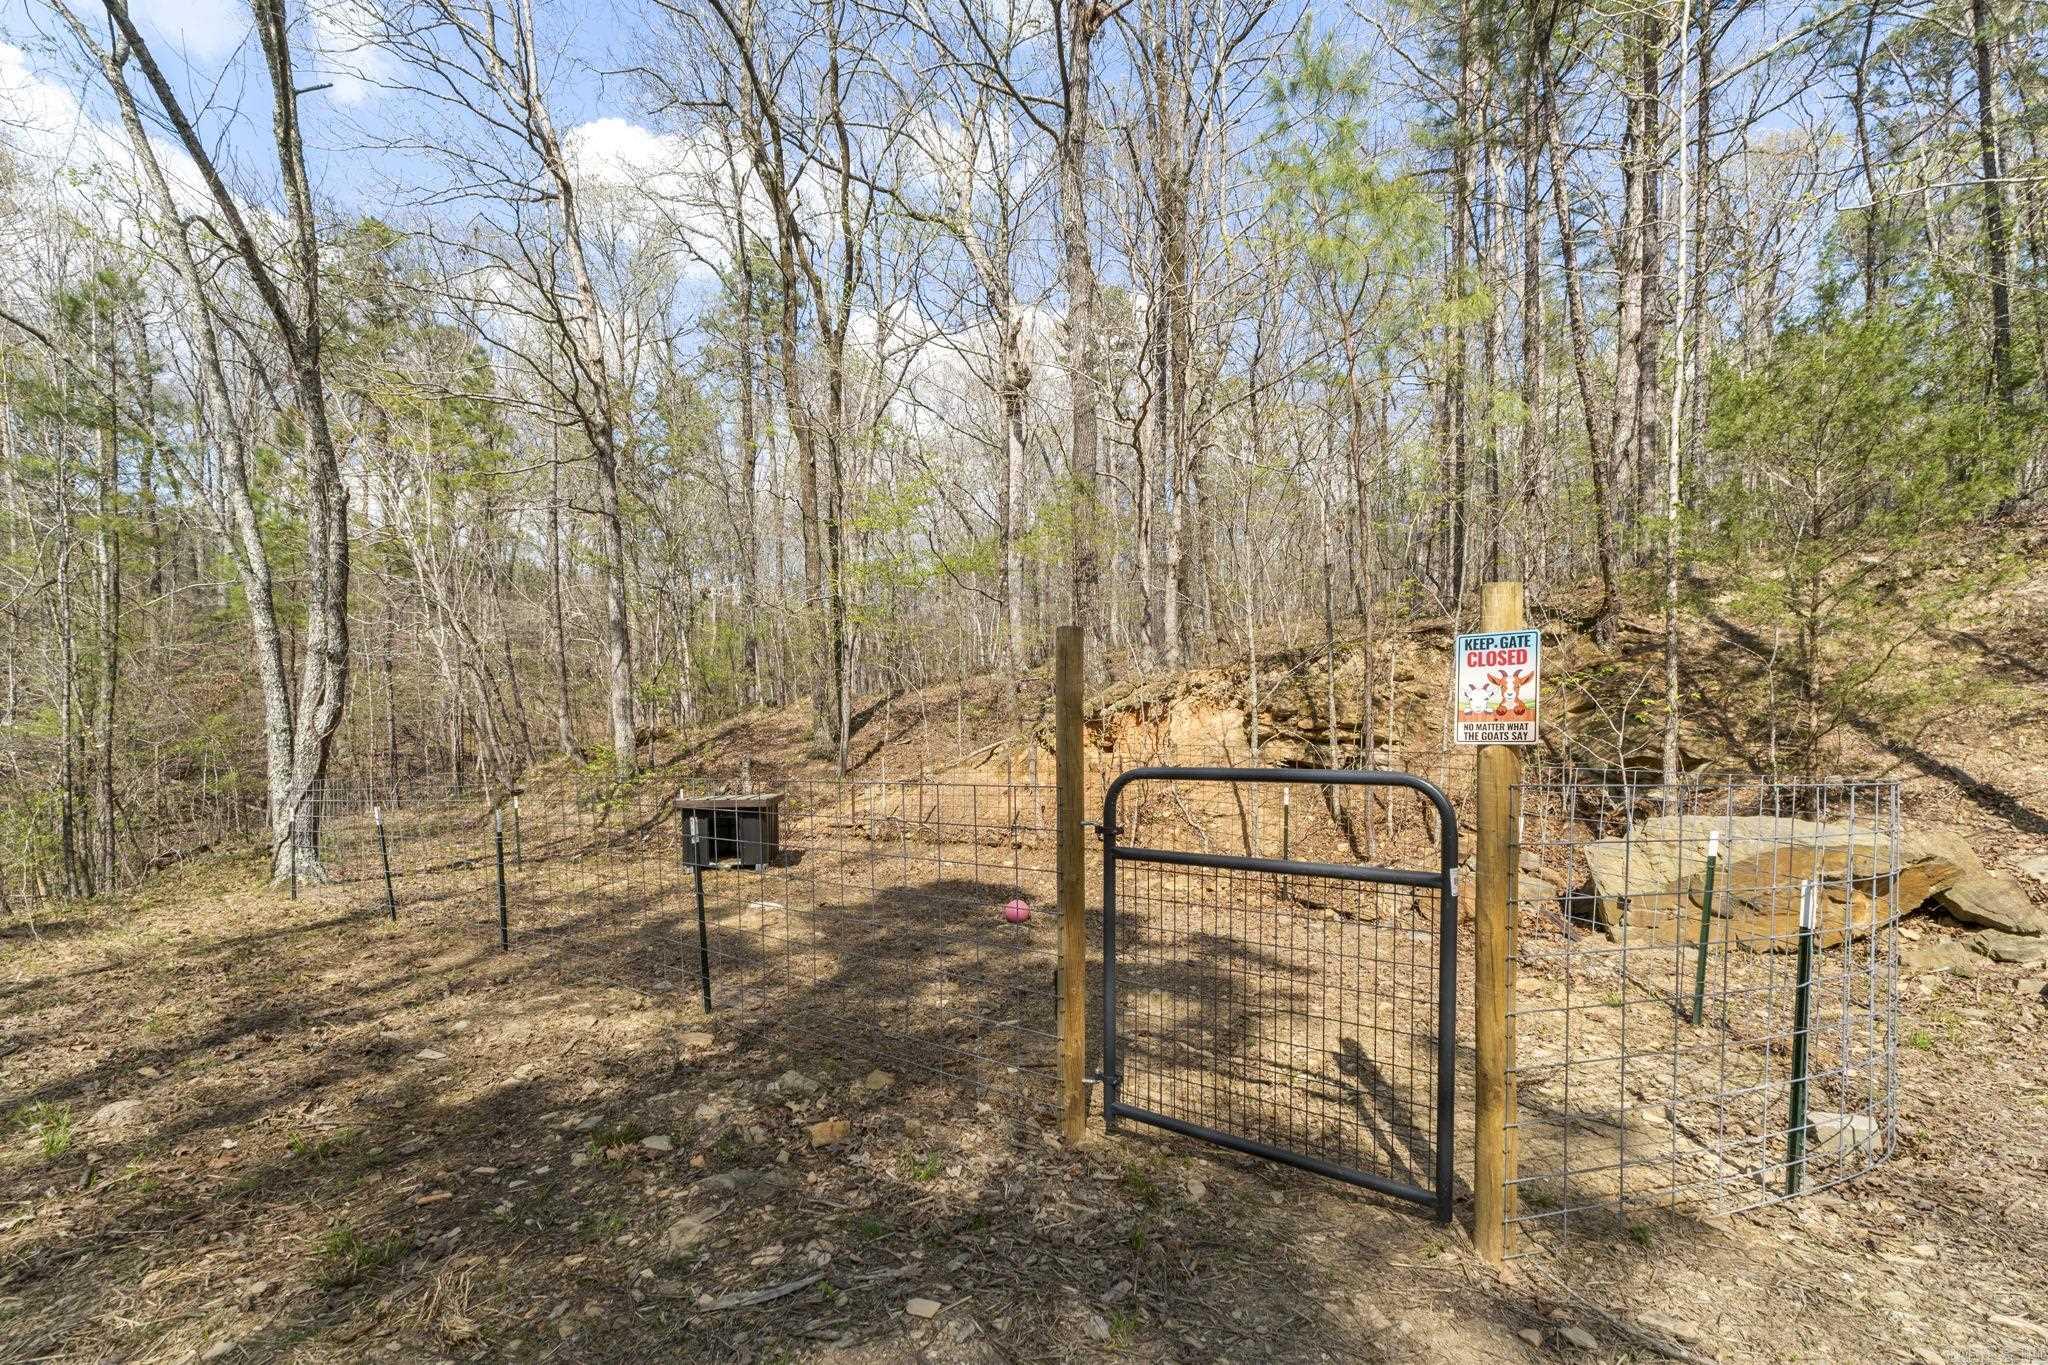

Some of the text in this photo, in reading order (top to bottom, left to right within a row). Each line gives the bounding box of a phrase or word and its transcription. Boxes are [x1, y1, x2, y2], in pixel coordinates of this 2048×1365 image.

[1465, 635, 1531, 651] KEEP GATE
[1467, 649, 1528, 667] CLOSED
[1464, 723, 1529, 731] NO MATTER WHAT
[1464, 732, 1528, 740] THE GOATS SAY
